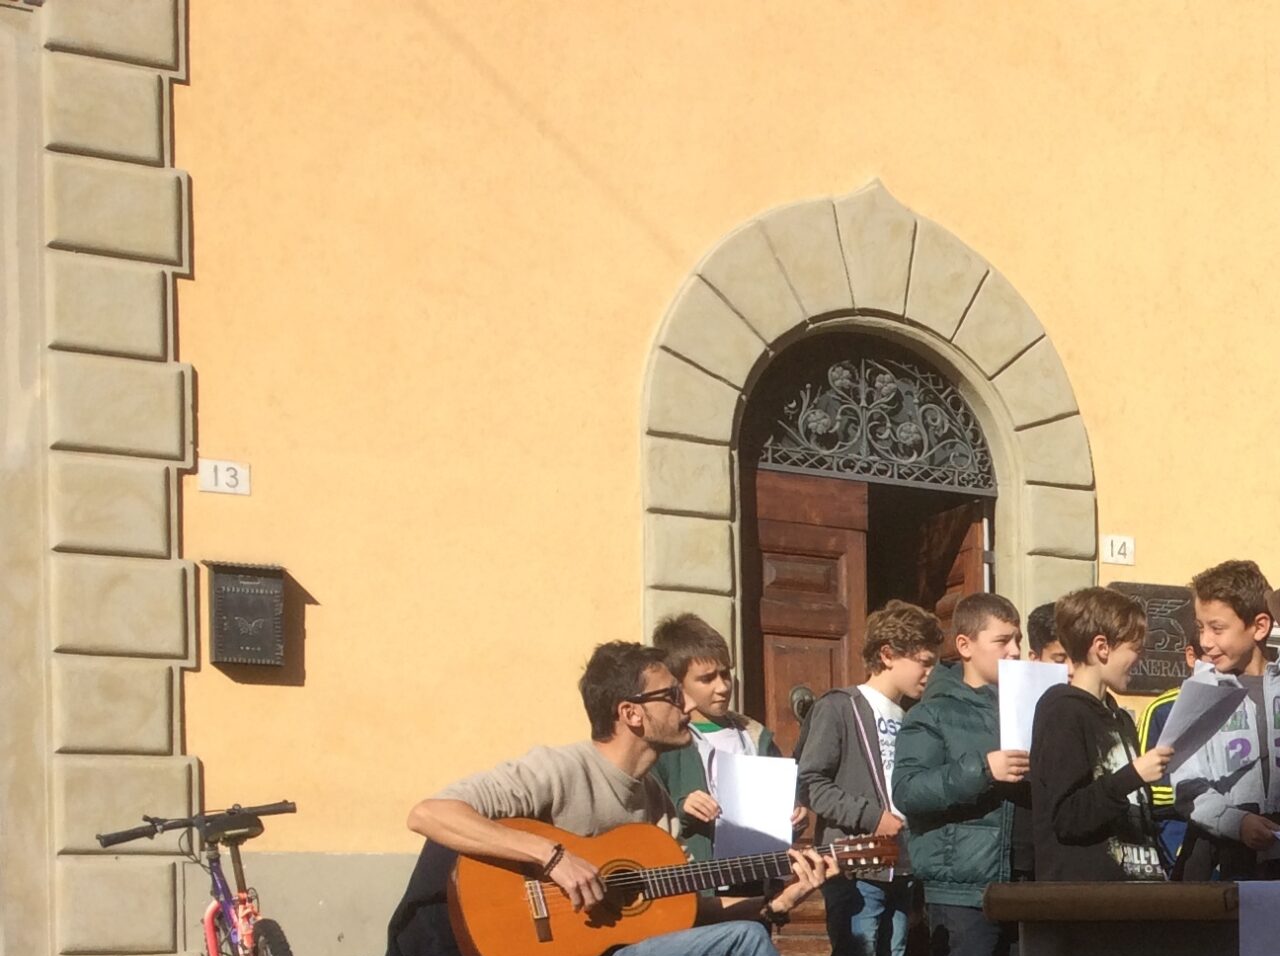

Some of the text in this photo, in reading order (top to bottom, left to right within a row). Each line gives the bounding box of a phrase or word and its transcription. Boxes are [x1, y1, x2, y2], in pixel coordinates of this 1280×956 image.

[213, 464, 239, 489] 13
[1110, 539, 1128, 559] 14
[1130, 659, 1189, 678] ENERAL
